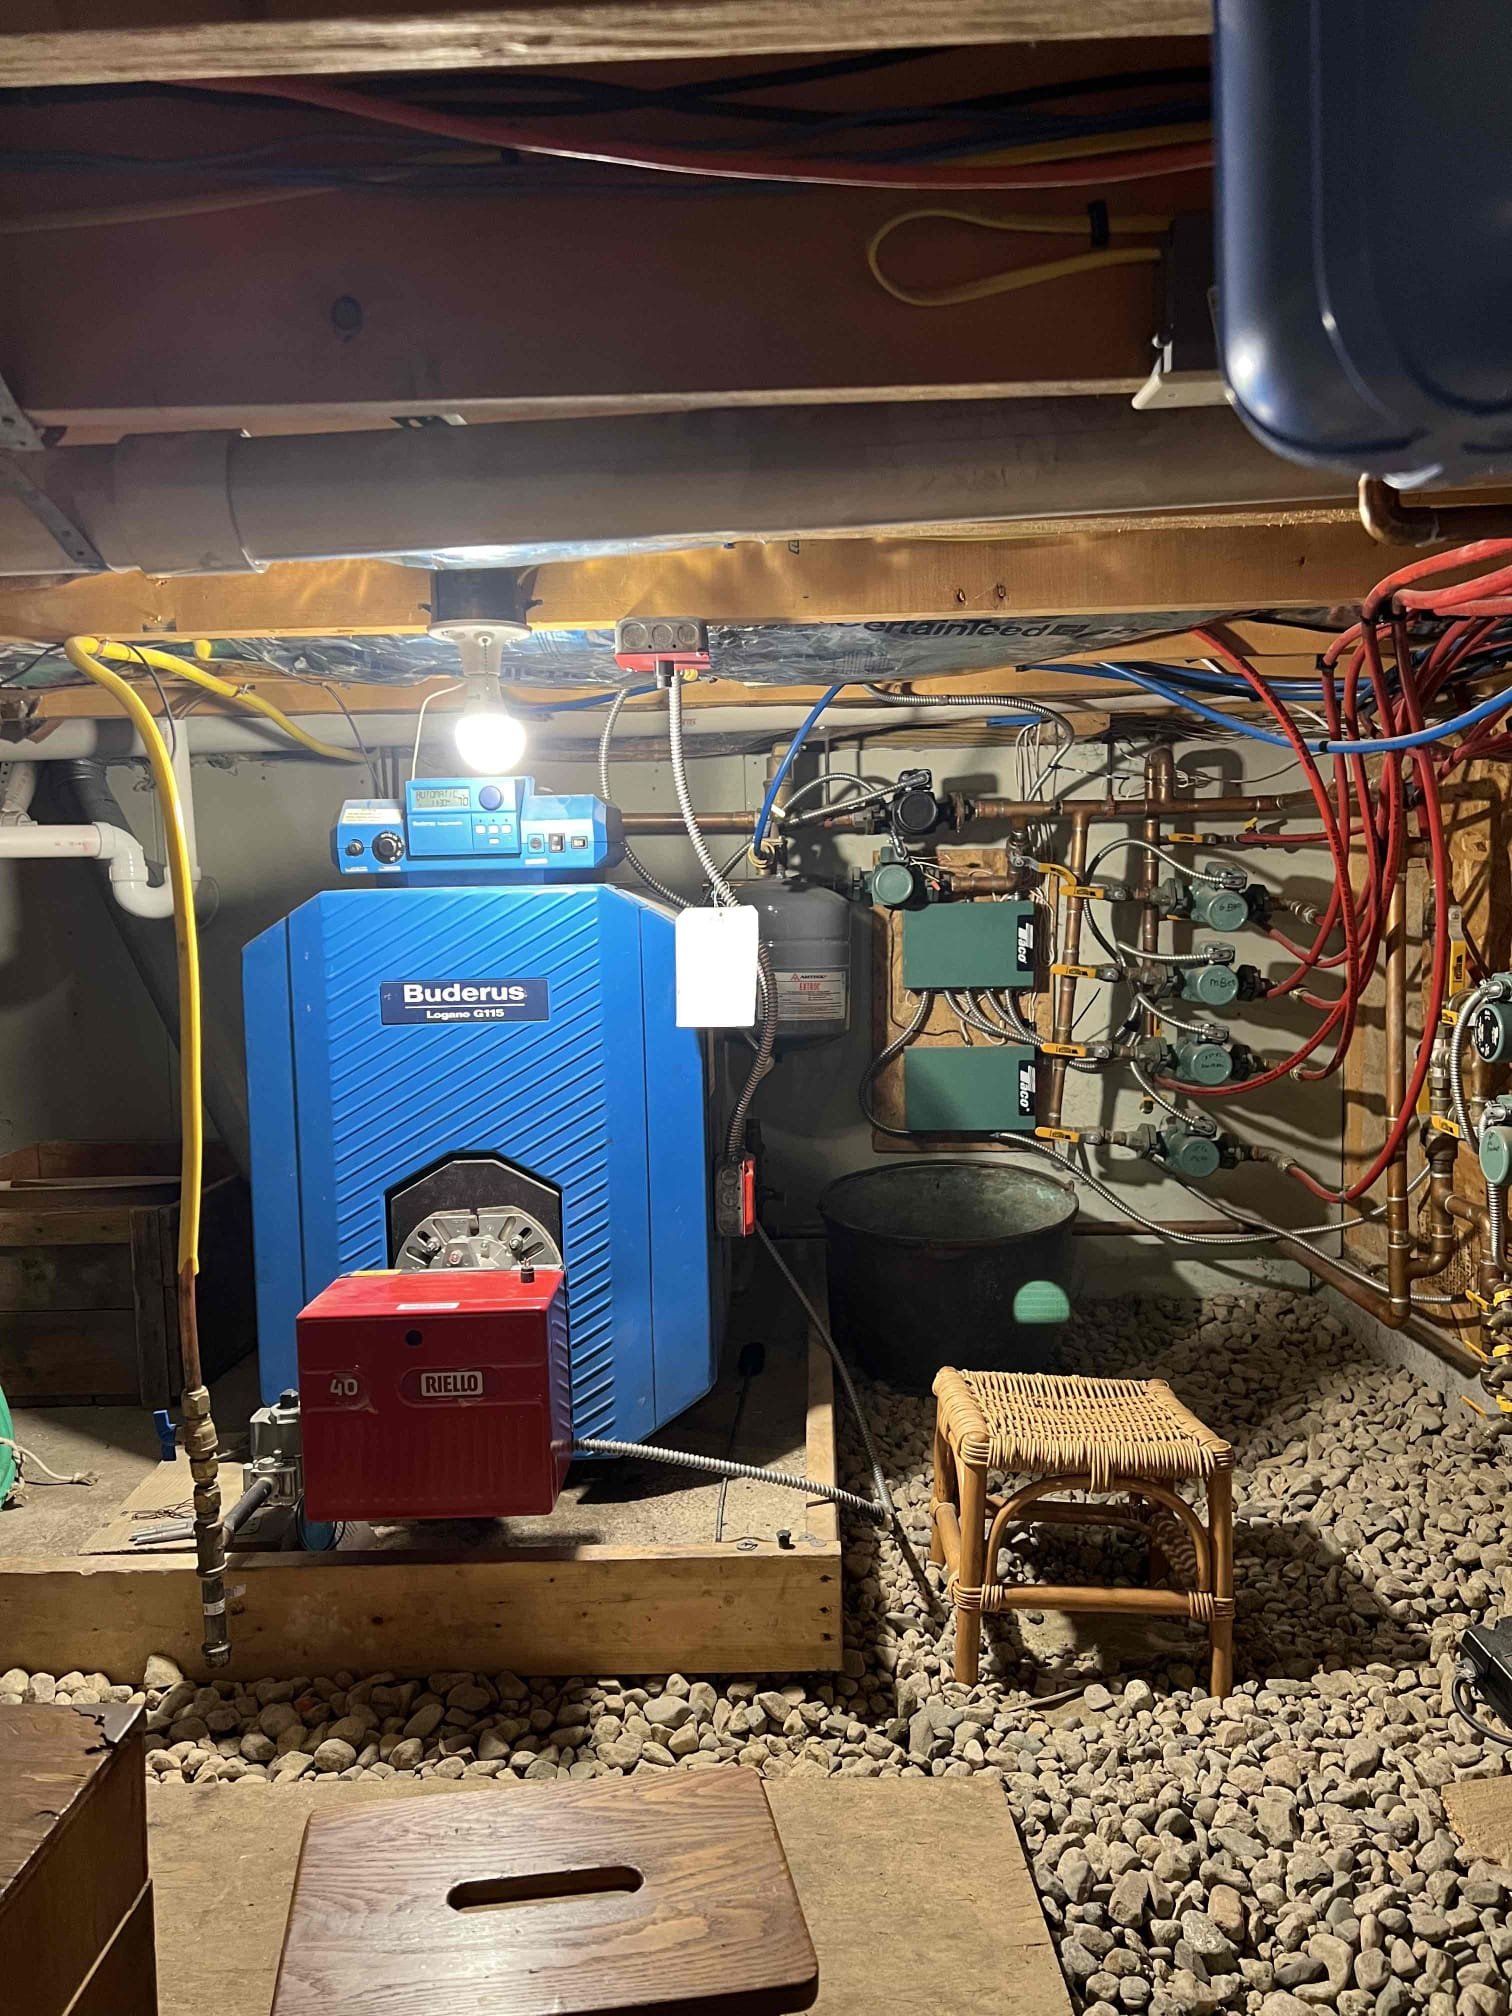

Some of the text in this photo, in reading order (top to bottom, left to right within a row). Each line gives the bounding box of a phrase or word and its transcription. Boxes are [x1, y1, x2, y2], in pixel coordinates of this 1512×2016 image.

[840, 619, 1050, 637] ertainTeed
[403, 983, 525, 1003] Buderus
[426, 1008, 505, 1020] Logano G115
[330, 1378, 358, 1396] 40
[425, 1374, 479, 1394] RIELLO
